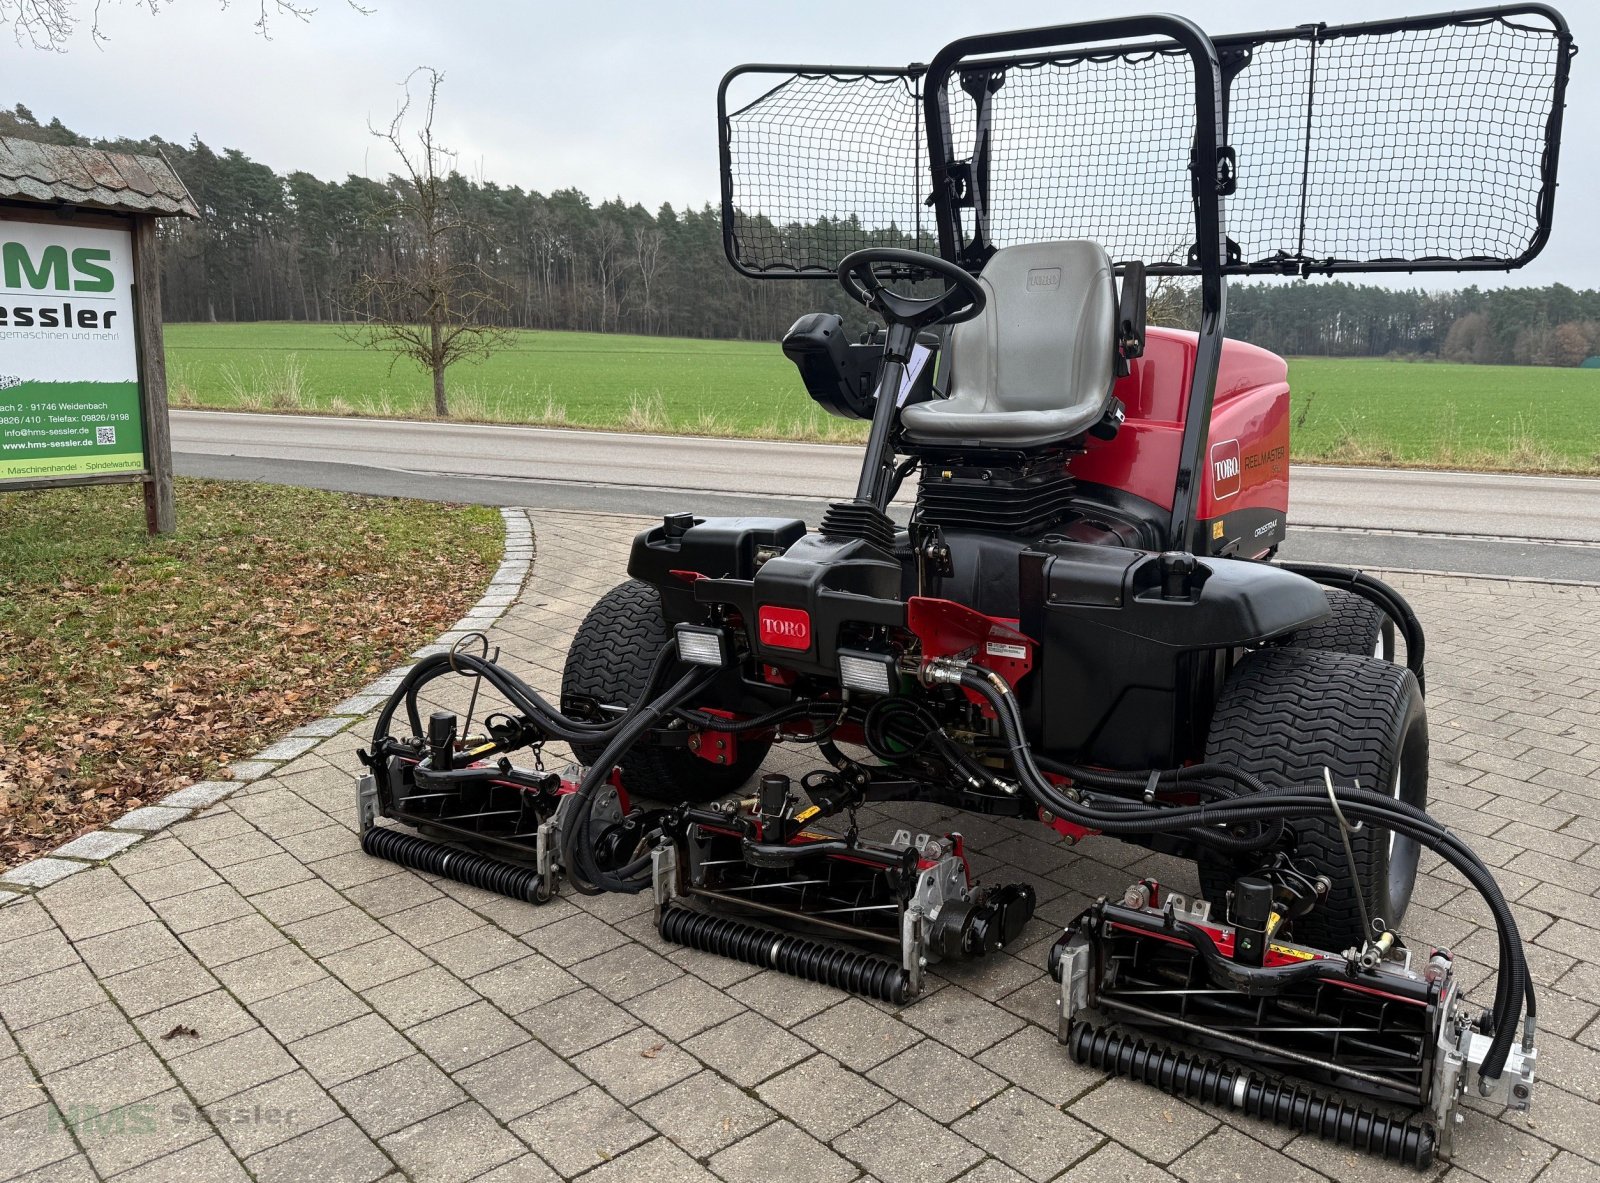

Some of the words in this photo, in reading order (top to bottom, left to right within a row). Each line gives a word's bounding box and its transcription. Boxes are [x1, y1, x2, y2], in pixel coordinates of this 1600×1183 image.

[71, 331, 90, 341] und
[17, 403, 23, 412] 2
[30, 403, 57, 411] 91746
[59, 402, 108, 411] Weidenbach
[48, 415, 79, 423] Telefax:
[81, 413, 129, 423] 09826/9198
[4, 427, 89, 437] info@hms-sessler.de
[2, 439, 93, 450] www.hms-sessler.de
[7, 463, 77, 475] Maschinenhandel
[85, 460, 141, 470] Spindelwartung
[1215, 456, 1239, 482] TORO
[1244, 446, 1285, 470] REELMASTER
[762, 618, 806, 638] TORO
